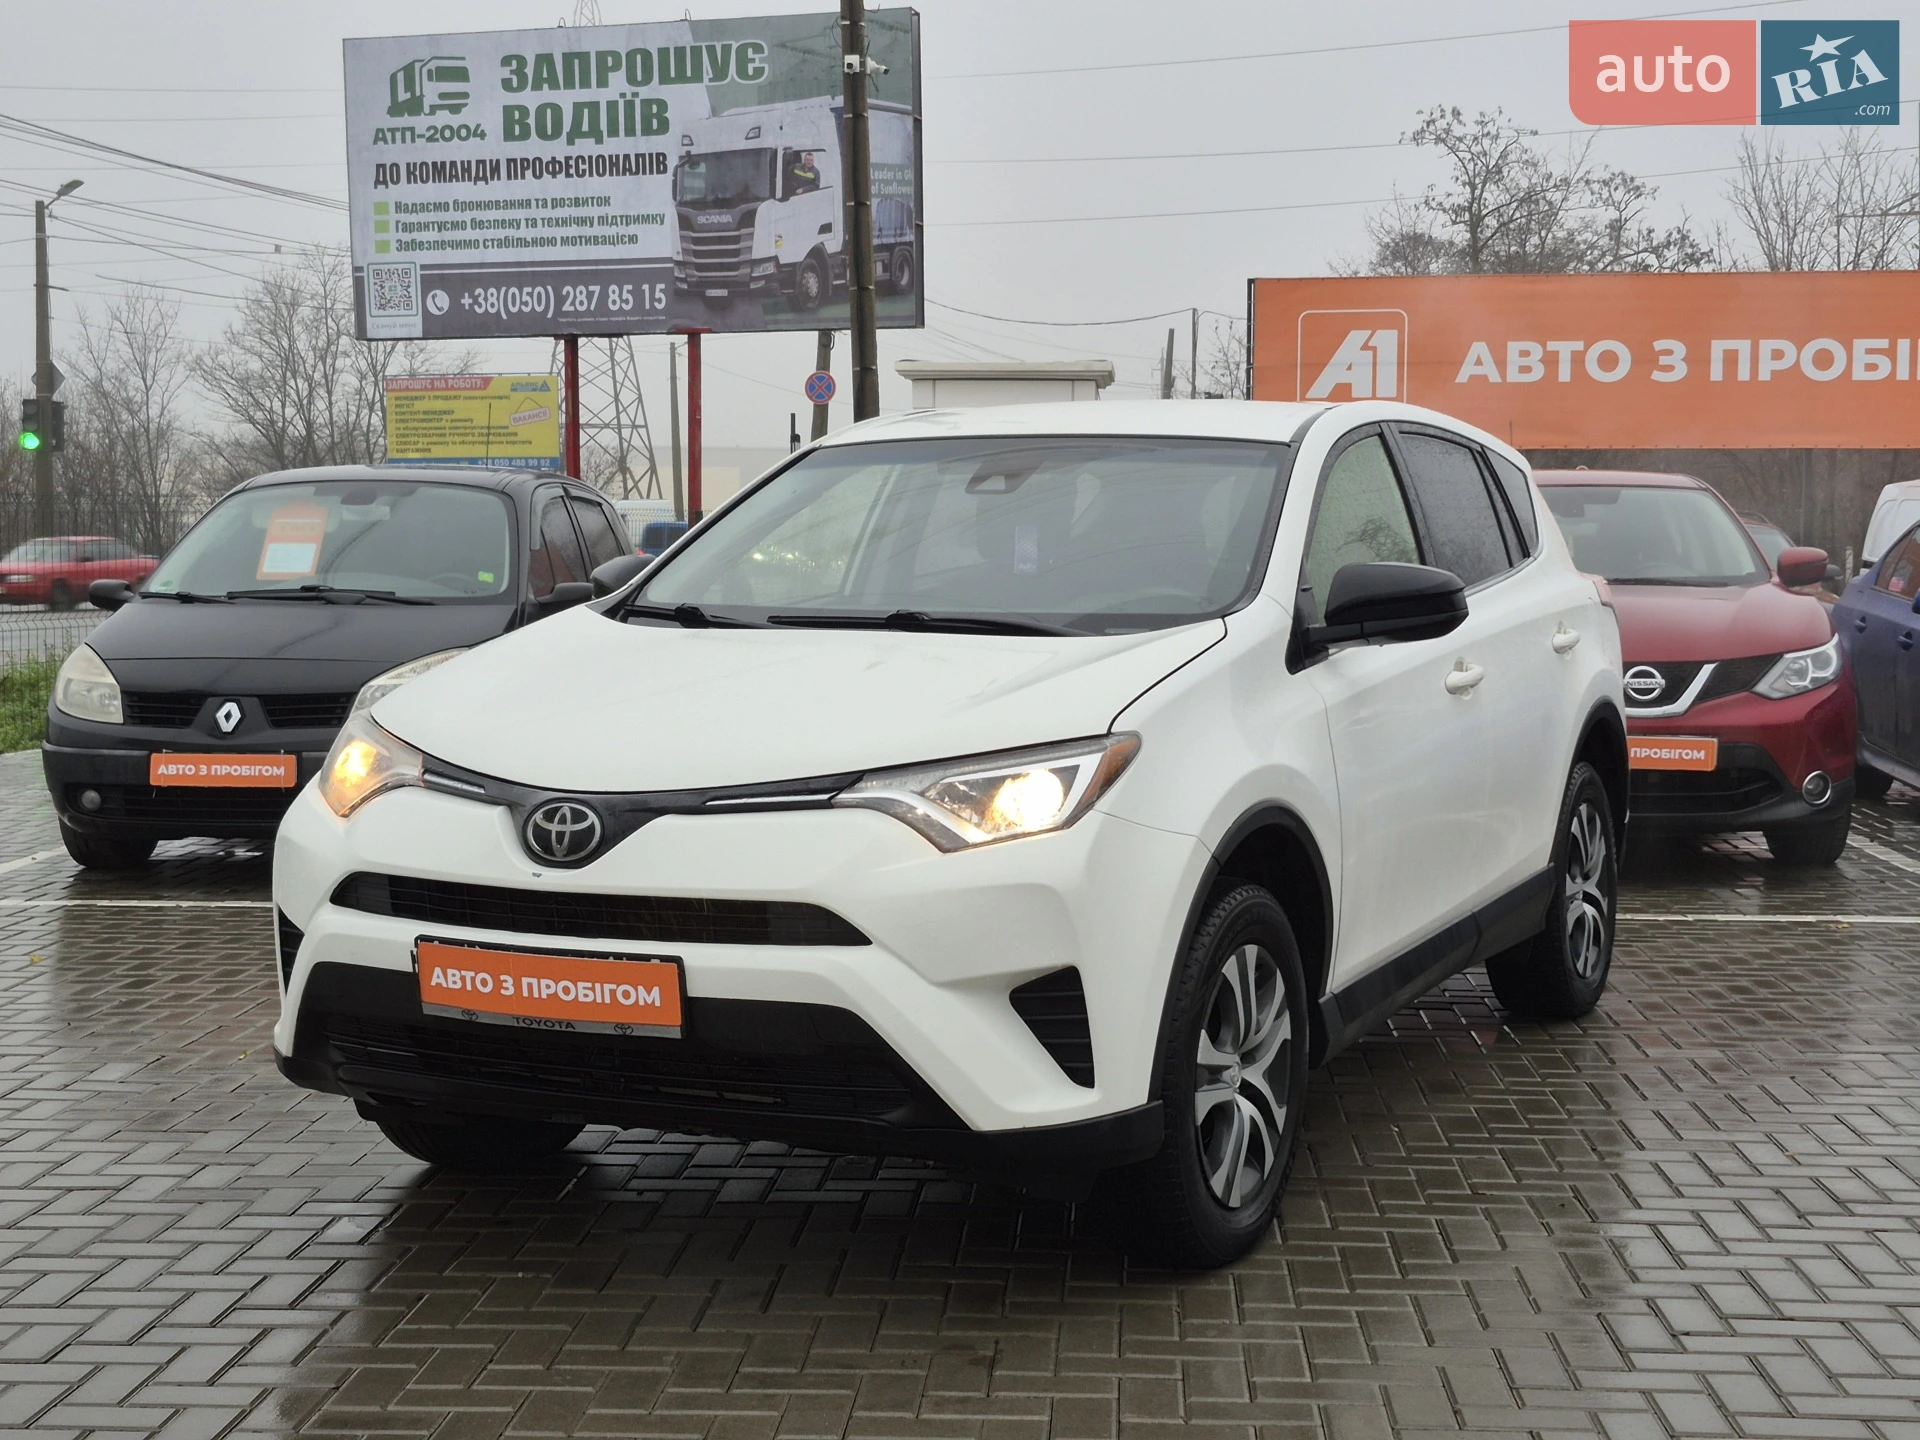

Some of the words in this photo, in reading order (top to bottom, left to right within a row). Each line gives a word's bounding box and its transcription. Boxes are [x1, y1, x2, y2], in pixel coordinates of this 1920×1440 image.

[500, 41, 767, 93] ЗАПРОШУЄ
[503, 92, 670, 147] ВОДІЇВ
[372, 123, 487, 146] АТП-2004
[374, 162, 401, 190] ДО
[405, 159, 501, 186] КОМАНДИ
[506, 152, 668, 181] ПРОФЕСІОНАЛІВ
[394, 201, 450, 216] Надаємо
[453, 198, 532, 213] бронювання
[534, 197, 548, 210] та
[551, 195, 611, 210] розвиток
[395, 219, 468, 234] Гарантуємо
[470, 217, 522, 231] безпеку
[524, 217, 538, 229] та
[540, 214, 595, 229] технічну
[597, 212, 666, 228] підтримку
[696, 214, 733, 224] SCANIA
[395, 238, 480, 253] Забезпечимо
[482, 235, 558, 250] стабільною
[560, 232, 639, 247] мотивацією
[460, 285, 555, 320] +38(050)
[562, 284, 601, 312] 287
[607, 284, 634, 311] 85
[641, 283, 667, 310] 15
[1454, 340, 1632, 383] АВТО
[1650, 339, 1688, 382] З
[1710, 338, 1920, 382] ПРОБІ
[387, 379, 432, 390] ЗАПРОШУЄ
[434, 379, 446, 389] НА
[448, 378, 484, 389] РОБОТУ:
[1630, 747, 1706, 760] ПРОБІГОМ
[157, 764, 196, 775] АВТО
[198, 764, 207, 775] З
[211, 764, 285, 776] ПРОБІГОМ
[430, 966, 494, 993] АВТО
[499, 974, 515, 996] З
[521, 977, 661, 1007] ПРОБІГОМ
[512, 1016, 576, 1031] TOYOTA
